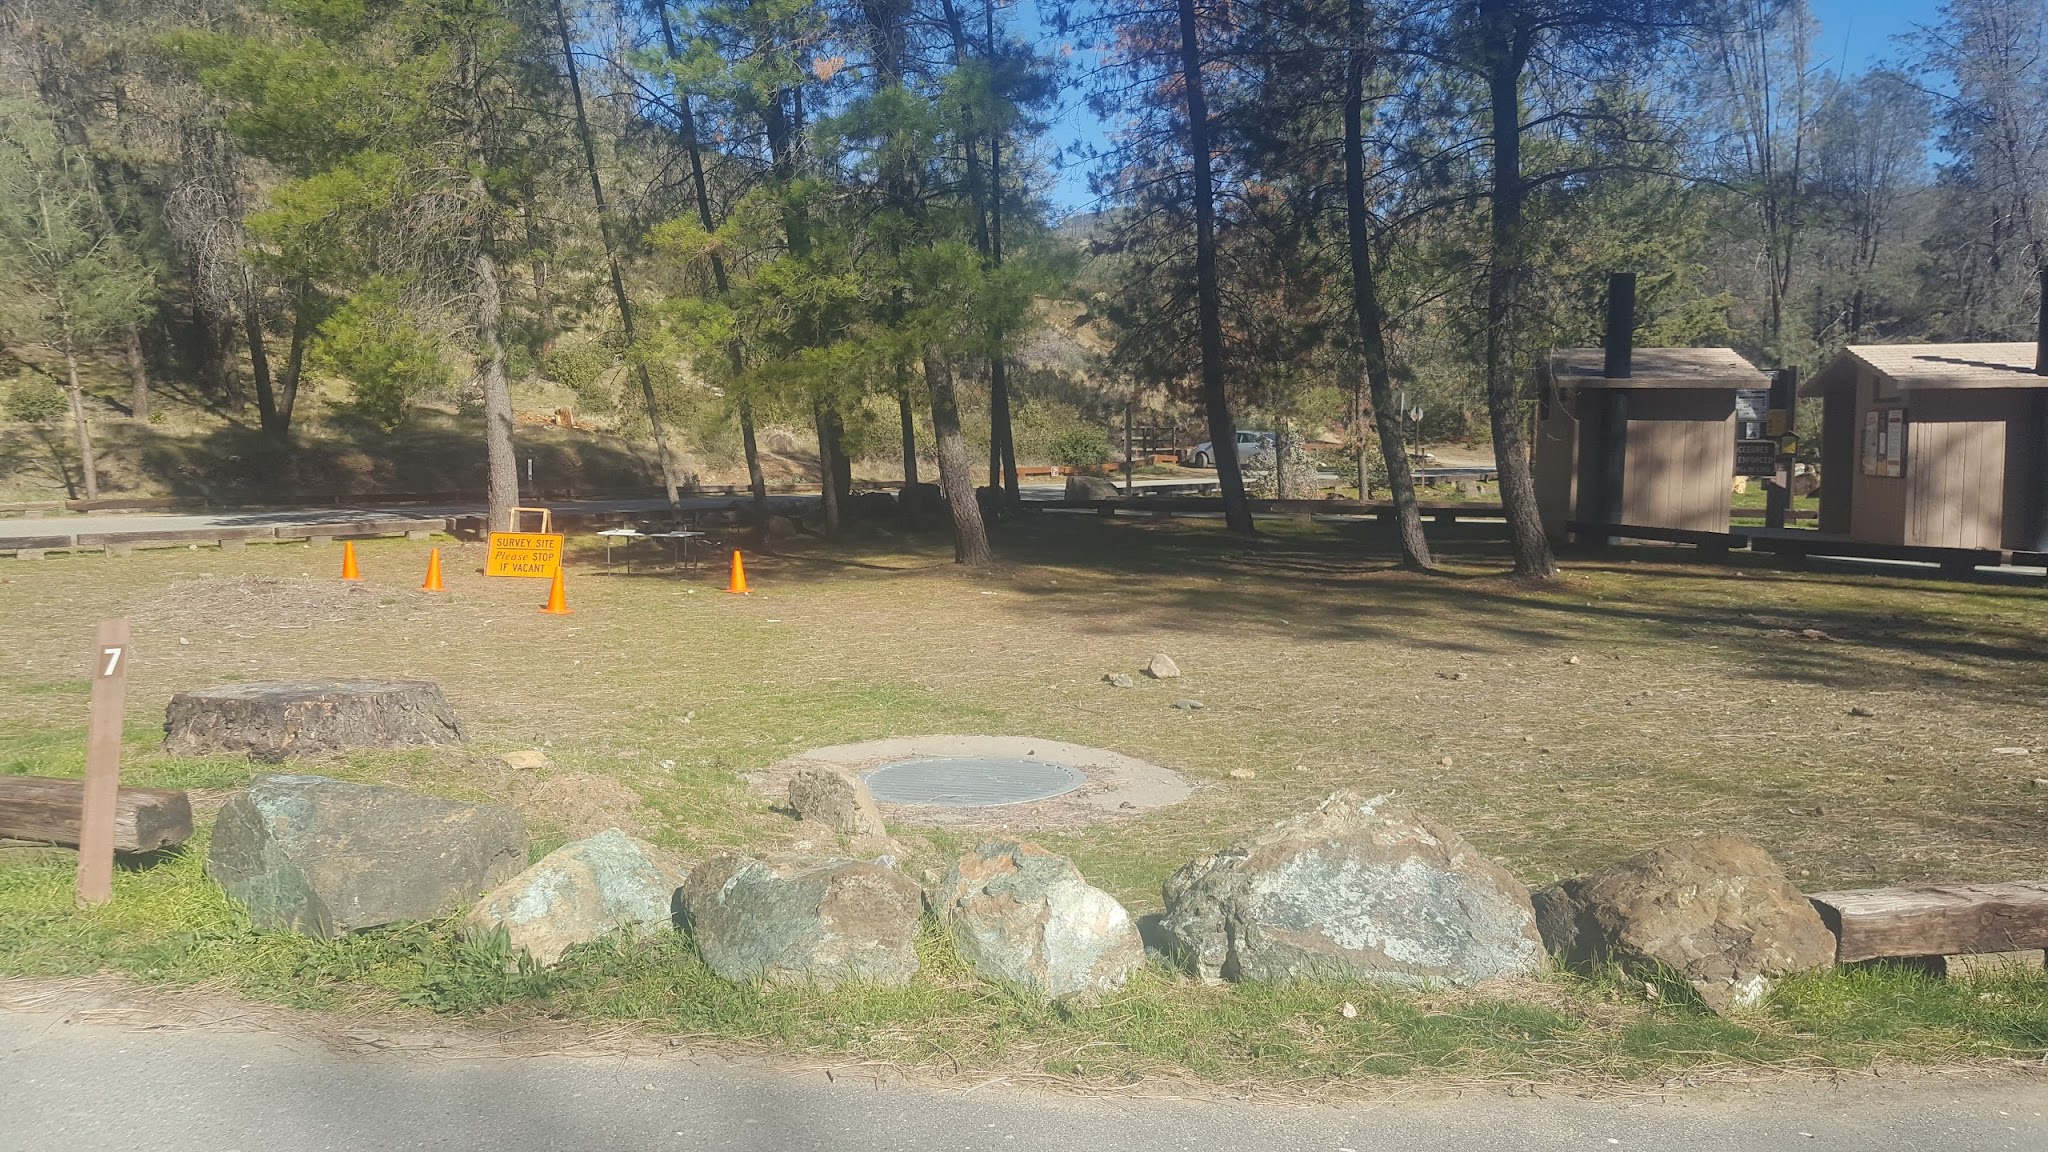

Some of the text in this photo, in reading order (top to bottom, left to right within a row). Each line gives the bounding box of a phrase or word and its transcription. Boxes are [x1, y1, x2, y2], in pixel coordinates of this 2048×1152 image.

[496, 538, 555, 548] SURVEY SITE
[495, 551, 554, 562] Please STOP
[500, 563, 545, 573] IF VACANT
[104, 647, 121, 676] 7
